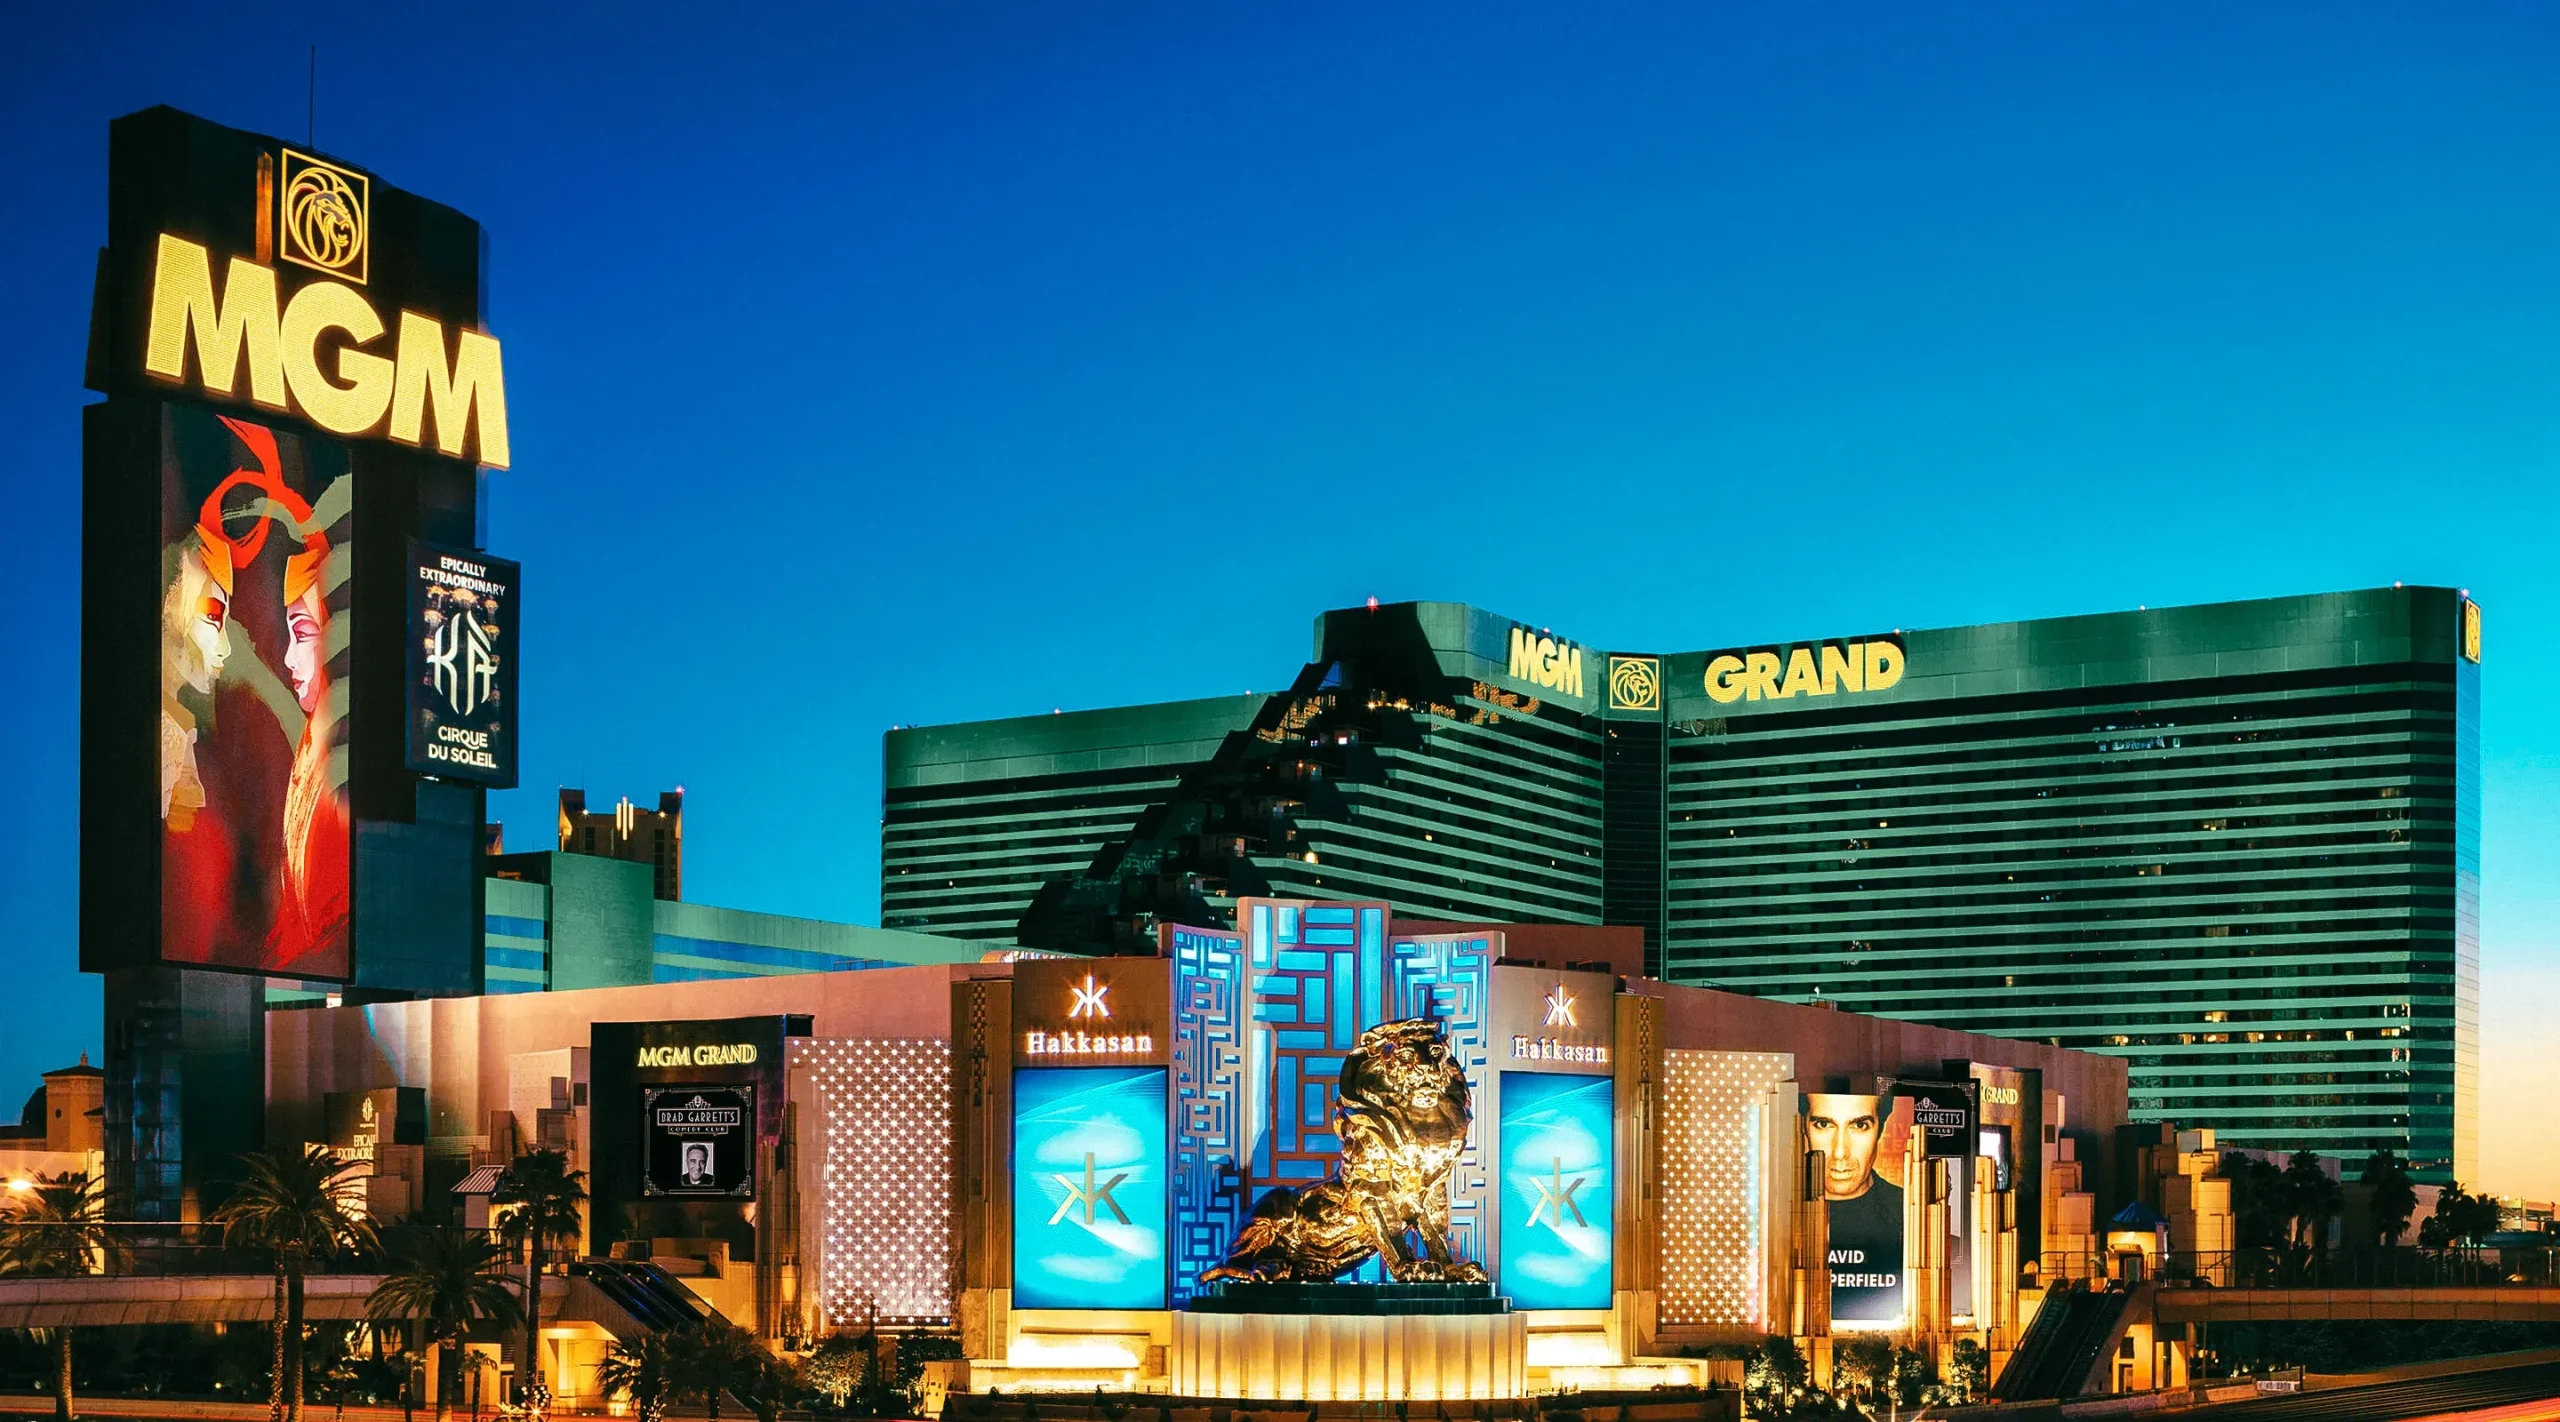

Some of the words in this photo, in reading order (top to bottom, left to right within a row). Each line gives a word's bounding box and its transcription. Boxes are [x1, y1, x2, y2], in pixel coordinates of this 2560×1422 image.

[145, 233, 510, 469] MGM
[441, 556, 486, 577] EPICALLY
[420, 567, 505, 596] EXTRAORDINARY
[1510, 627, 1583, 698] MGM
[1704, 641, 1904, 703] GRAND
[438, 726, 488, 749] CIRQUE
[428, 744, 448, 760] DU
[451, 747, 497, 768] SOLEIL
[1026, 1031, 1153, 1054] Hakkasan
[1512, 1036, 1608, 1062] Hakkasan
[638, 1046, 691, 1067] MGM
[694, 1044, 757, 1065] GRAND
[1986, 1087, 2018, 1104] GRAND
[661, 1112, 684, 1123] BRAD
[688, 1111, 735, 1122] GARRETT'S
[1916, 1112, 1960, 1125] GARRETT'S
[1828, 1250, 1864, 1263] AVID
[1831, 1273, 1896, 1287] PERFIELD
